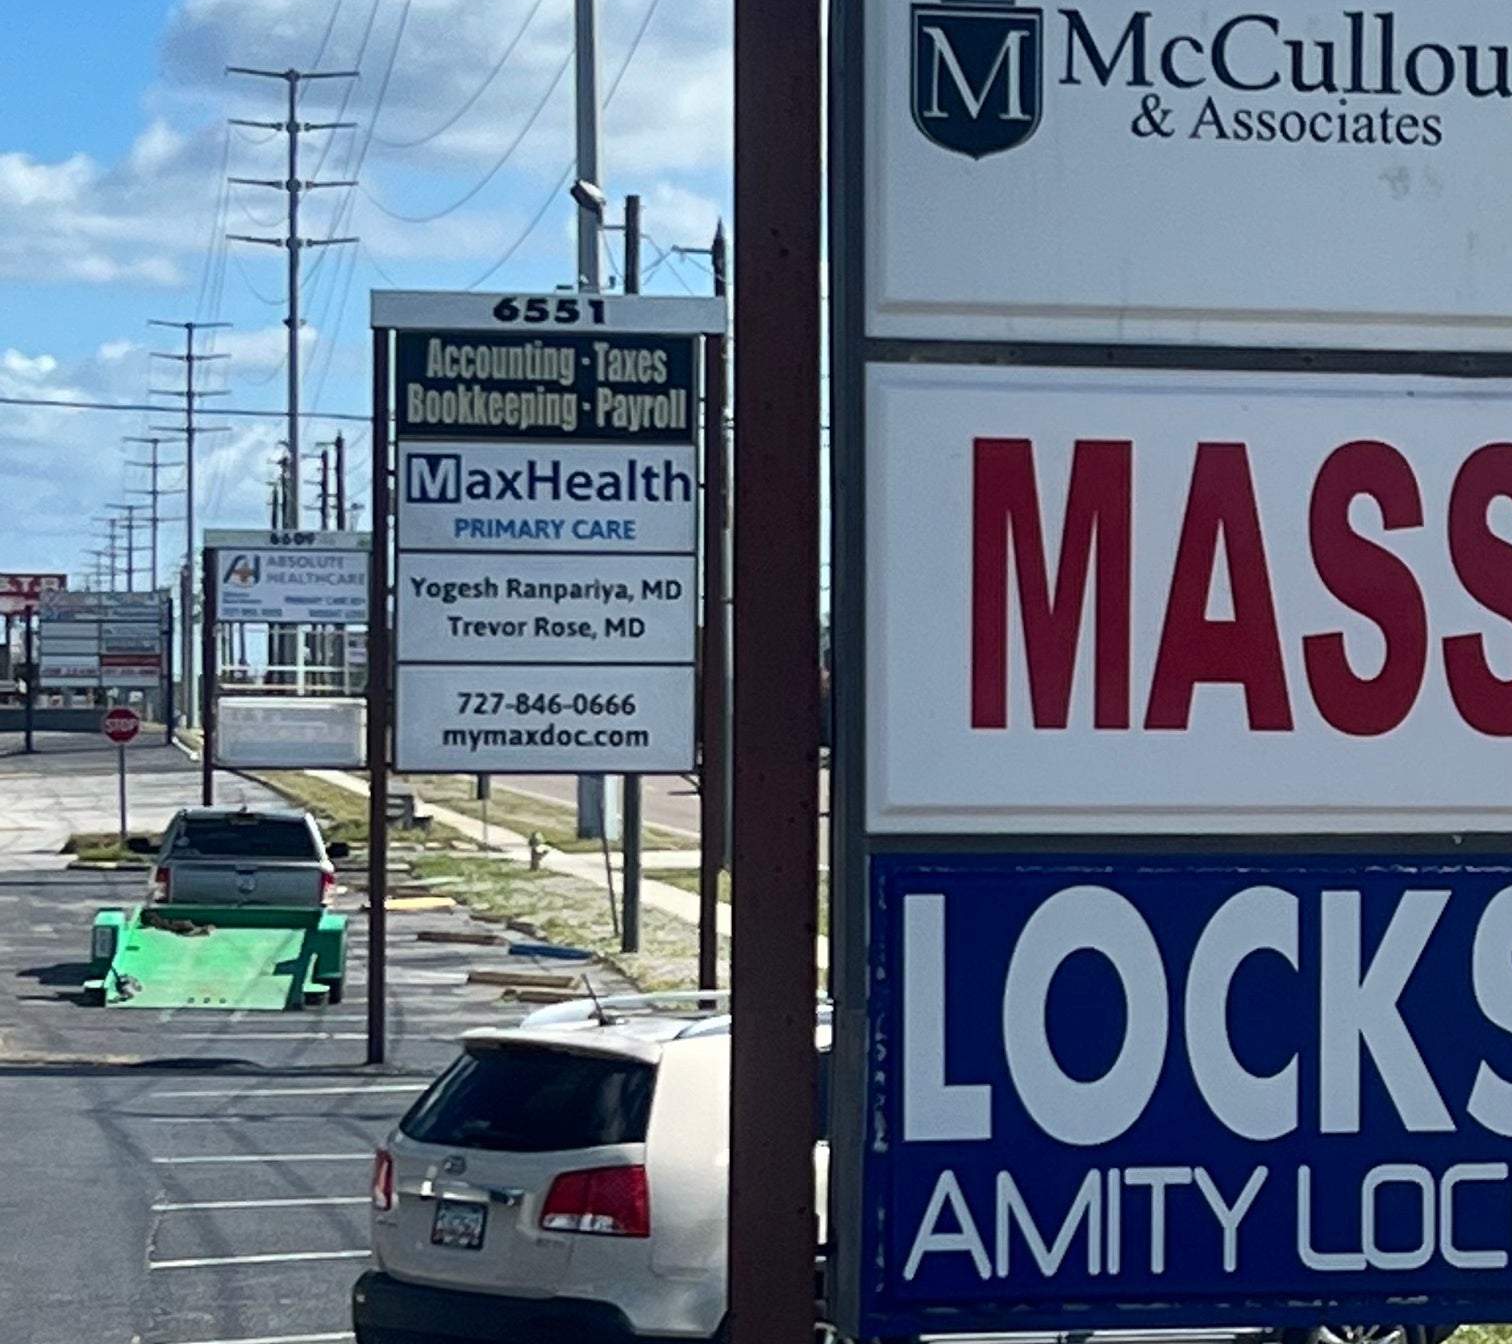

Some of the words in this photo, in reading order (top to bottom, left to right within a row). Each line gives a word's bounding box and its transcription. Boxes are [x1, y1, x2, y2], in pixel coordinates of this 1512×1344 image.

[1130, 93, 1175, 139] &
[1188, 97, 1444, 147] Associates
[492, 296, 605, 325] 6551
[426, 337, 576, 387] Accounting
[593, 341, 668, 384] Taxes
[406, 382, 578, 432] Bookkeeping
[596, 386, 687, 432] Payroll
[407, 453, 692, 505] MaxHealth
[454, 517, 566, 540] PRIMARY
[571, 519, 636, 541] CARE
[266, 555, 344, 570] ABSOLUTE
[266, 571, 366, 586] HEALTHCARE
[410, 576, 499, 603] Yogesh
[505, 578, 635, 605] Ranpariya,
[641, 579, 683, 601] MD
[447, 615, 528, 638] Trevor
[534, 616, 597, 640] Rose,
[604, 617, 646, 638] MD
[457, 691, 637, 716] 727-846-0666
[105, 717, 139, 732] STOP
[442, 722, 649, 752] mymaxdoc.com
[903, 1165, 1269, 1281] AMITY
